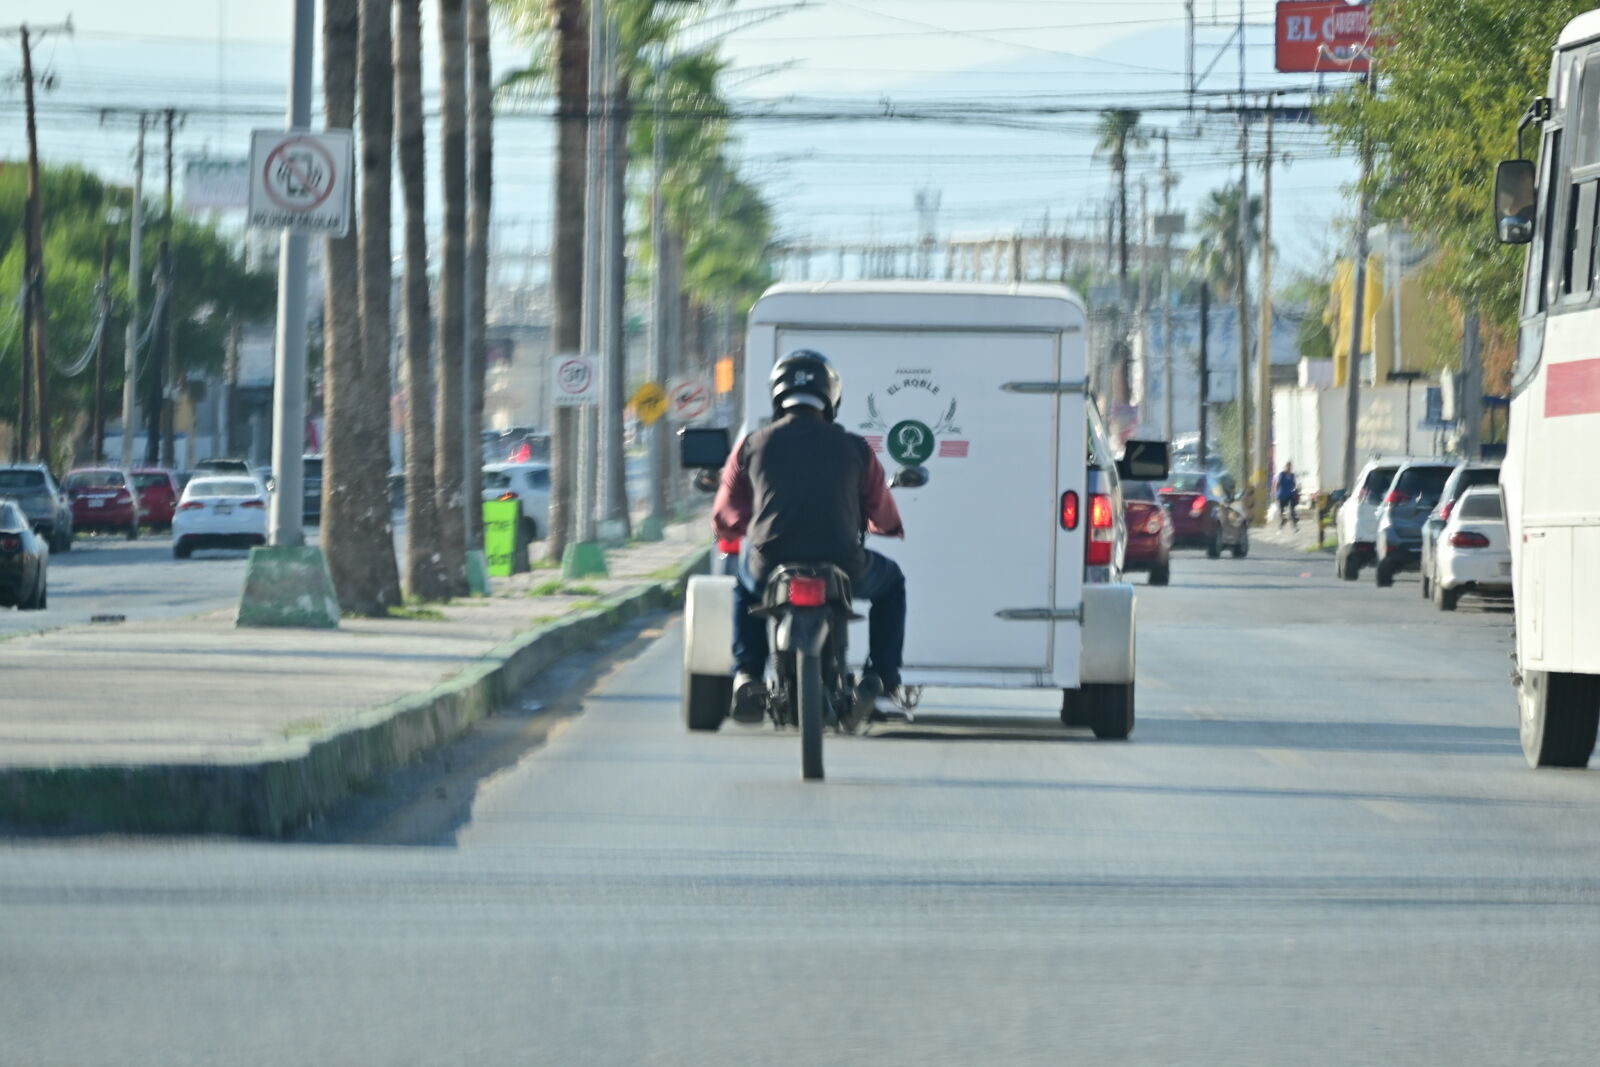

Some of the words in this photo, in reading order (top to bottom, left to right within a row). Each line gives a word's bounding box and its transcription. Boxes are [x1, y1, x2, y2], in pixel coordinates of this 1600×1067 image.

[1286, 15, 1317, 42] EL
[886, 383, 901, 396] EL
[903, 378, 940, 396] ROBLE
